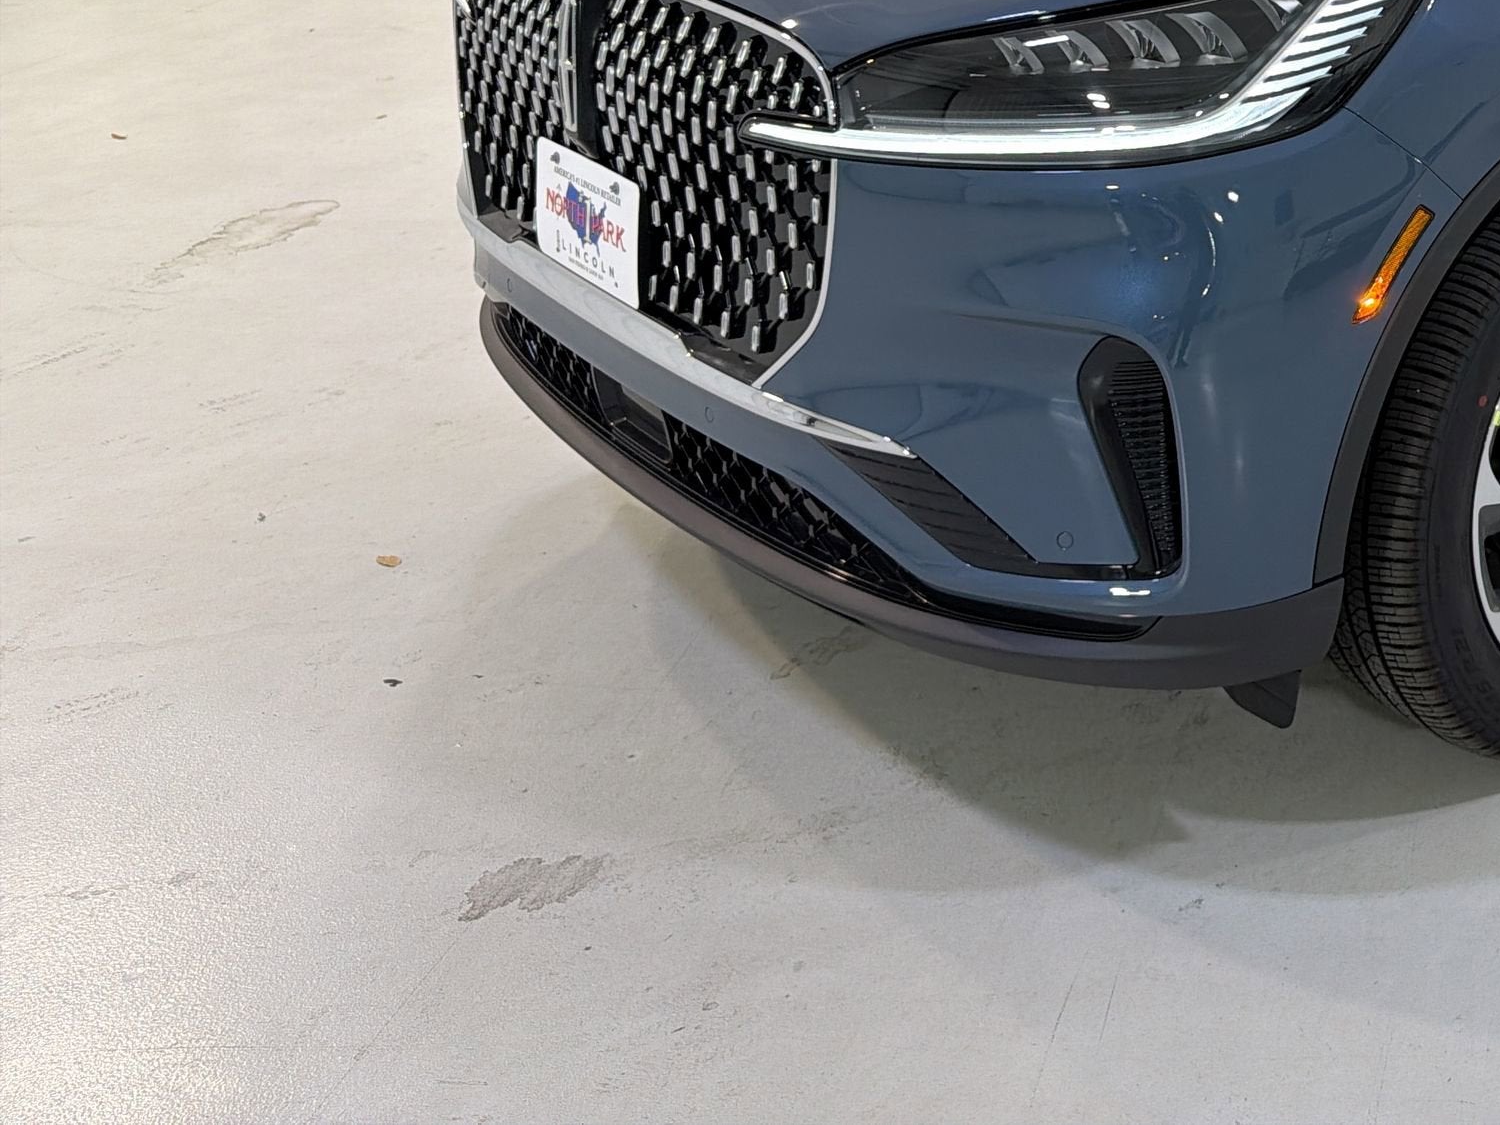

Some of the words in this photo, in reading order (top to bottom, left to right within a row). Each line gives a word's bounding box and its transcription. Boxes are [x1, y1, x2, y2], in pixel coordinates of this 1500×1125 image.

[546, 186, 585, 226] NORTH
[591, 213, 626, 252] PARK
[562, 238, 615, 279] LINCOLN
